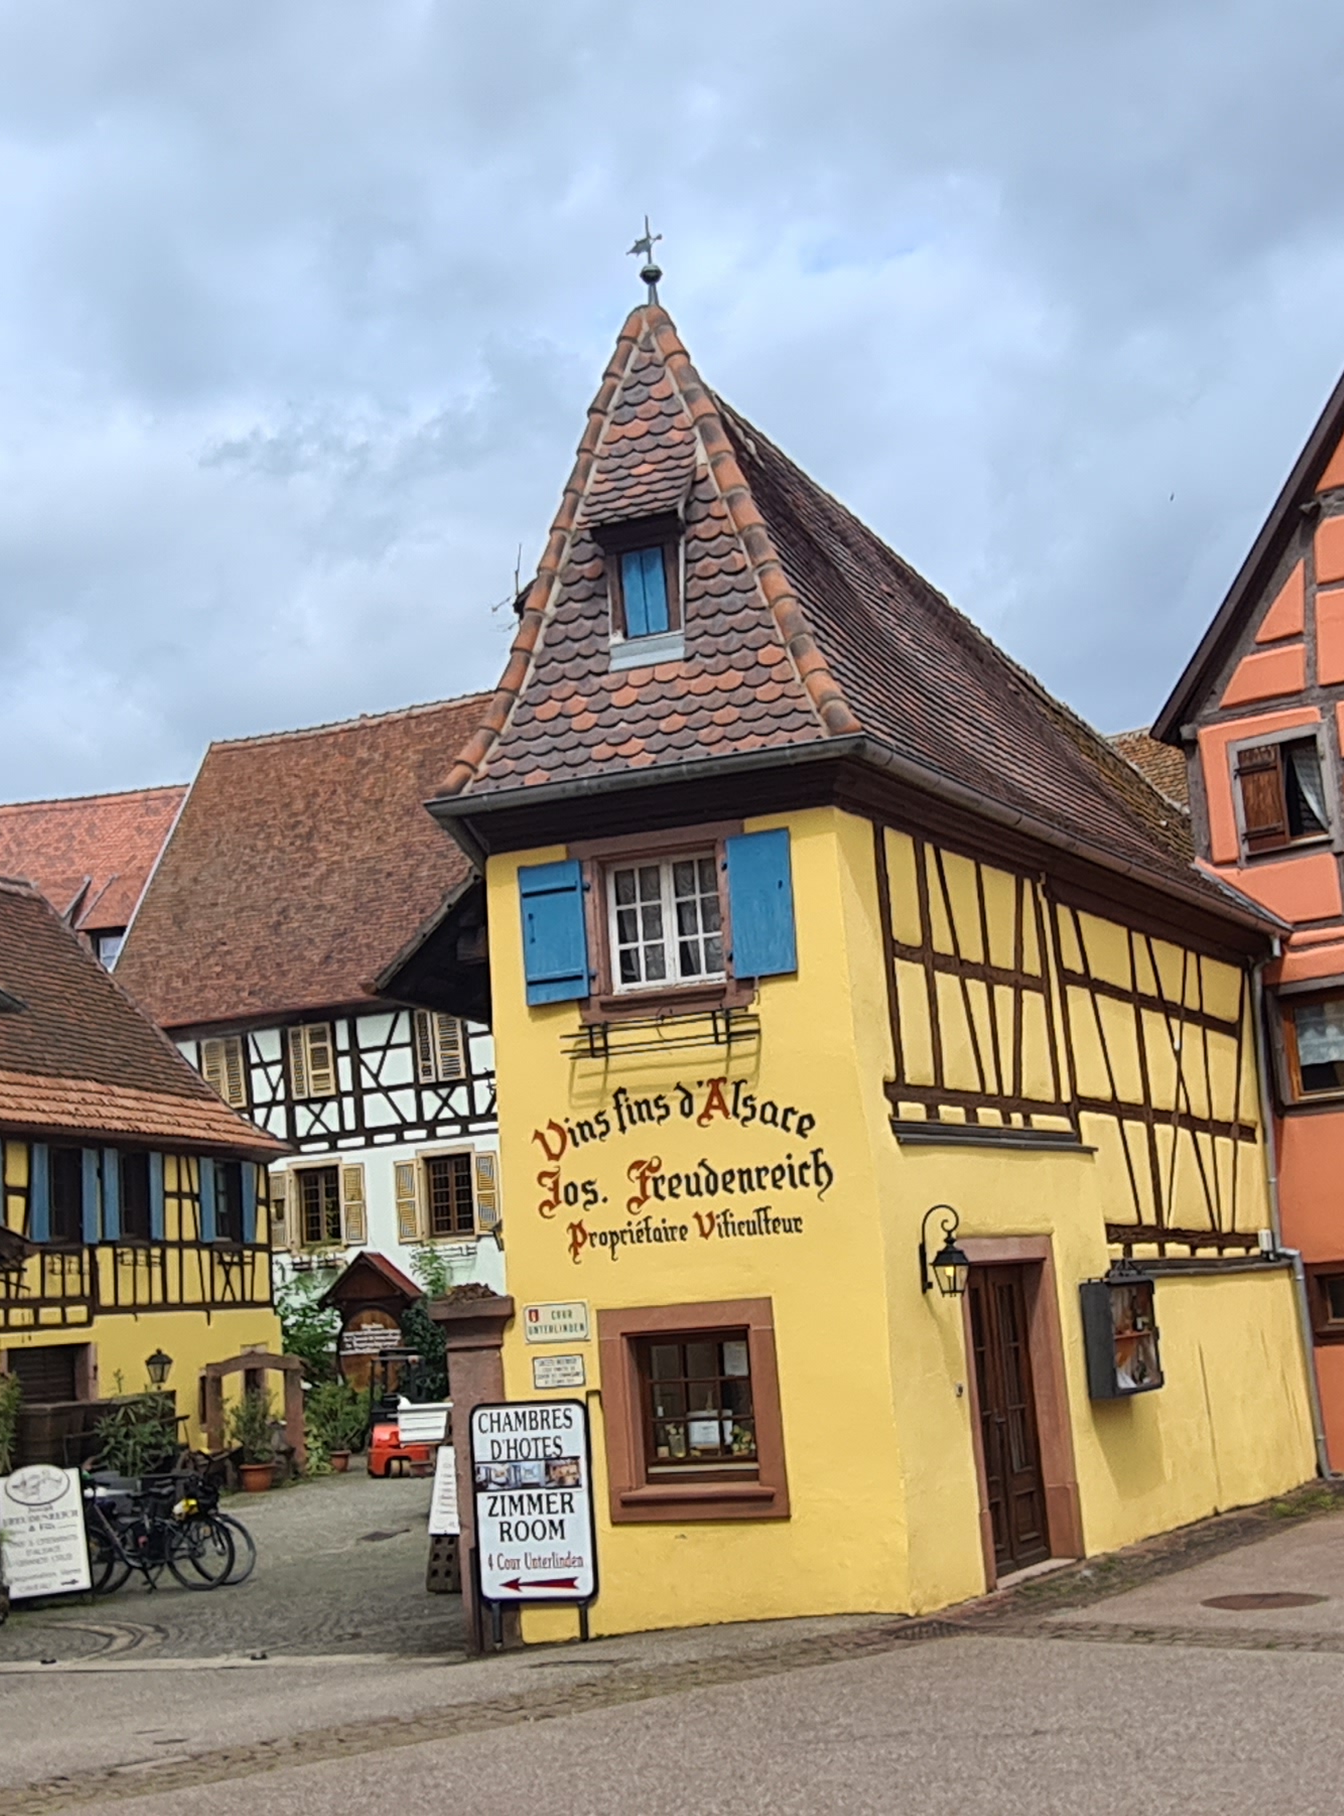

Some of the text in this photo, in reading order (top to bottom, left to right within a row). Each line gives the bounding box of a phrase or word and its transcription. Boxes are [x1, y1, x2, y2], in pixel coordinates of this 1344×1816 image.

[532, 1076, 816, 1162] Vins fins d'Alsace
[536, 1147, 834, 1220] Jos. Freudenreich
[566, 1205, 803, 1265] Propriétaire Viticulteur
[478, 1407, 573, 1434] CHAMBRES
[490, 1435, 563, 1461] D'HOTES
[487, 1491, 575, 1518] ZIMMER
[499, 1518, 566, 1542] ROOM
[496, 1552, 521, 1571] Cour
[524, 1551, 584, 1570] Unterlinden
